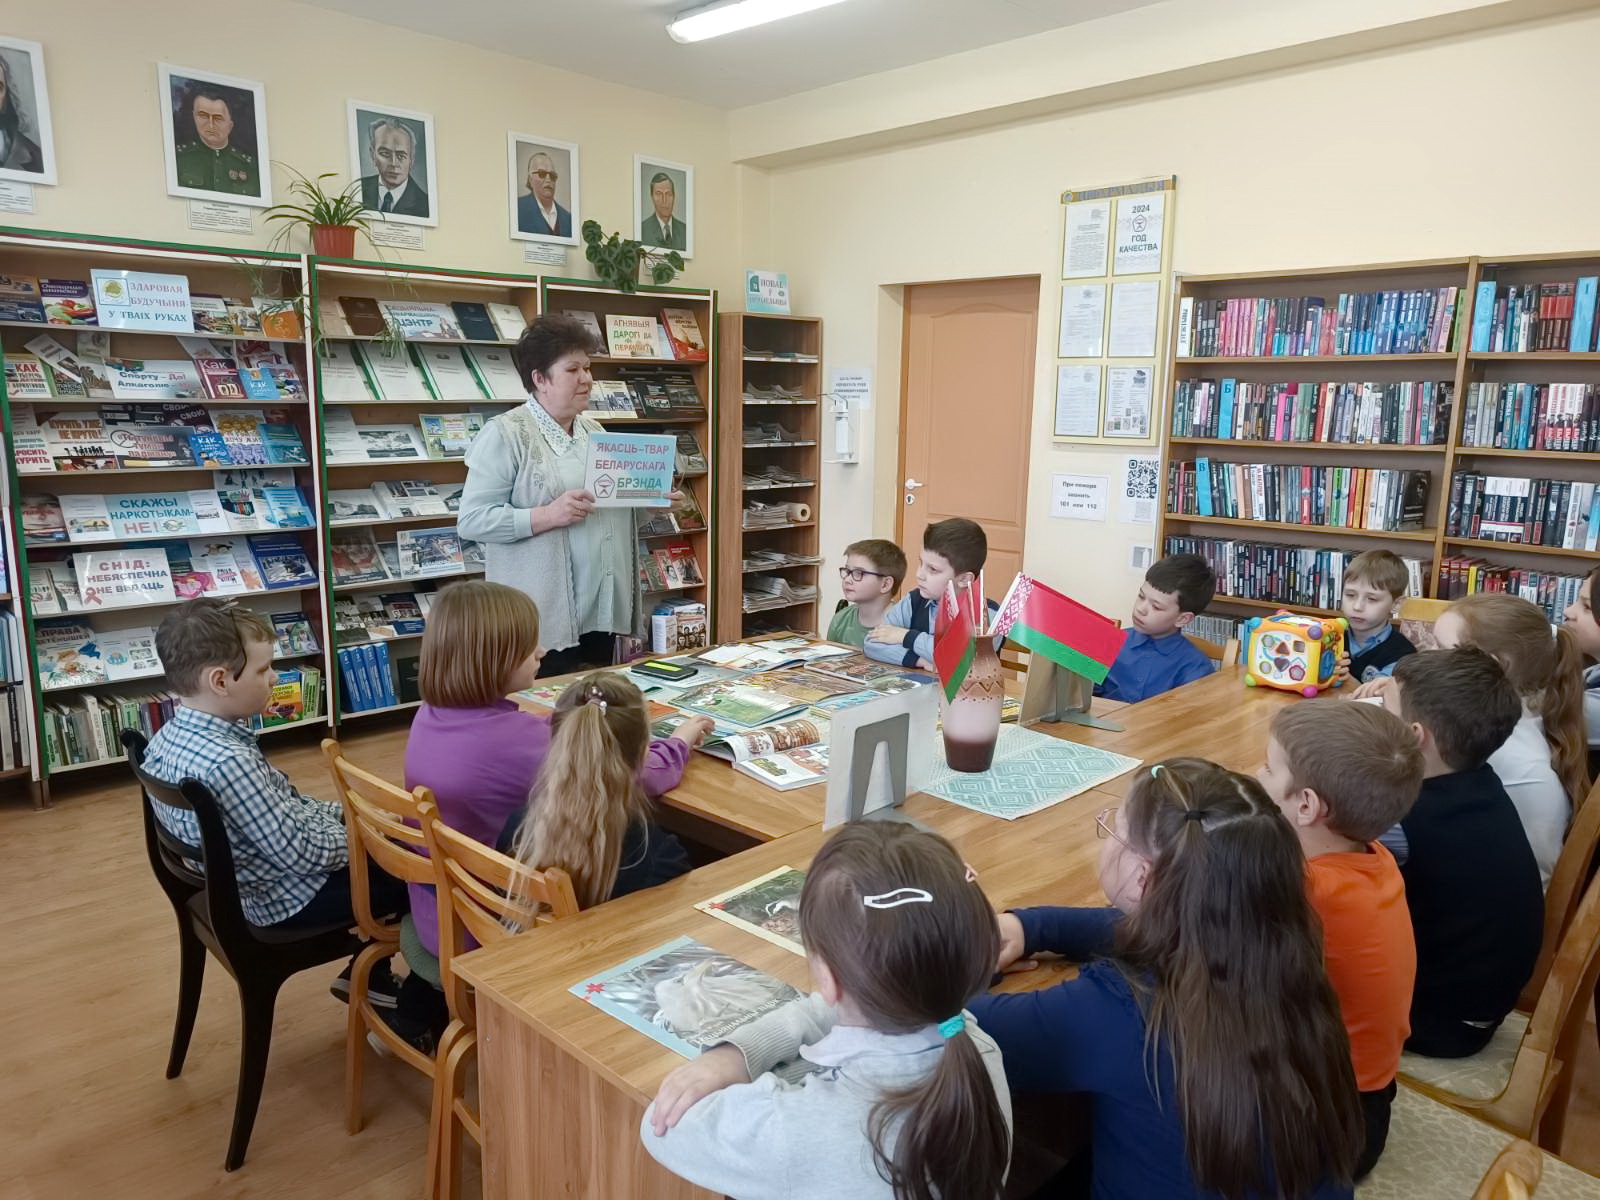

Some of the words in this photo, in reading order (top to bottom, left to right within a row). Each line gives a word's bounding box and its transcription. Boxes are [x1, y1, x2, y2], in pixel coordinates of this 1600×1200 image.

[1131, 204, 1150, 214] 2024
[1131, 234, 1147, 244] ГОД
[1119, 243, 1158, 254] КАЧЕСТВА
[130, 282, 183, 294] ЗДАРОВАЯ
[130, 297, 186, 308] БУДУЧЫНЯ
[108, 309, 116, 319] У
[120, 311, 151, 321] ТВАІХ
[155, 312, 188, 322] РУКАХ
[613, 319, 650, 328] АГНЯВЫЯ
[15, 363, 39, 372] КАК
[201, 359, 227, 370] Как
[119, 371, 158, 381] Спорту
[1224, 383, 1231, 394] Б
[595, 459, 666, 471] БЕЛАРУСКАГА
[1198, 462, 1206, 472] В
[617, 478, 662, 490] БРЭНДА
[119, 498, 178, 509] СКАЖЫ
[98, 560, 151, 571] СНІД:
[87, 570, 168, 583] НЕБЯСПЕЧНА
[96, 586, 113, 594] НЕ
[40, 626, 81, 637] ПРАВА
